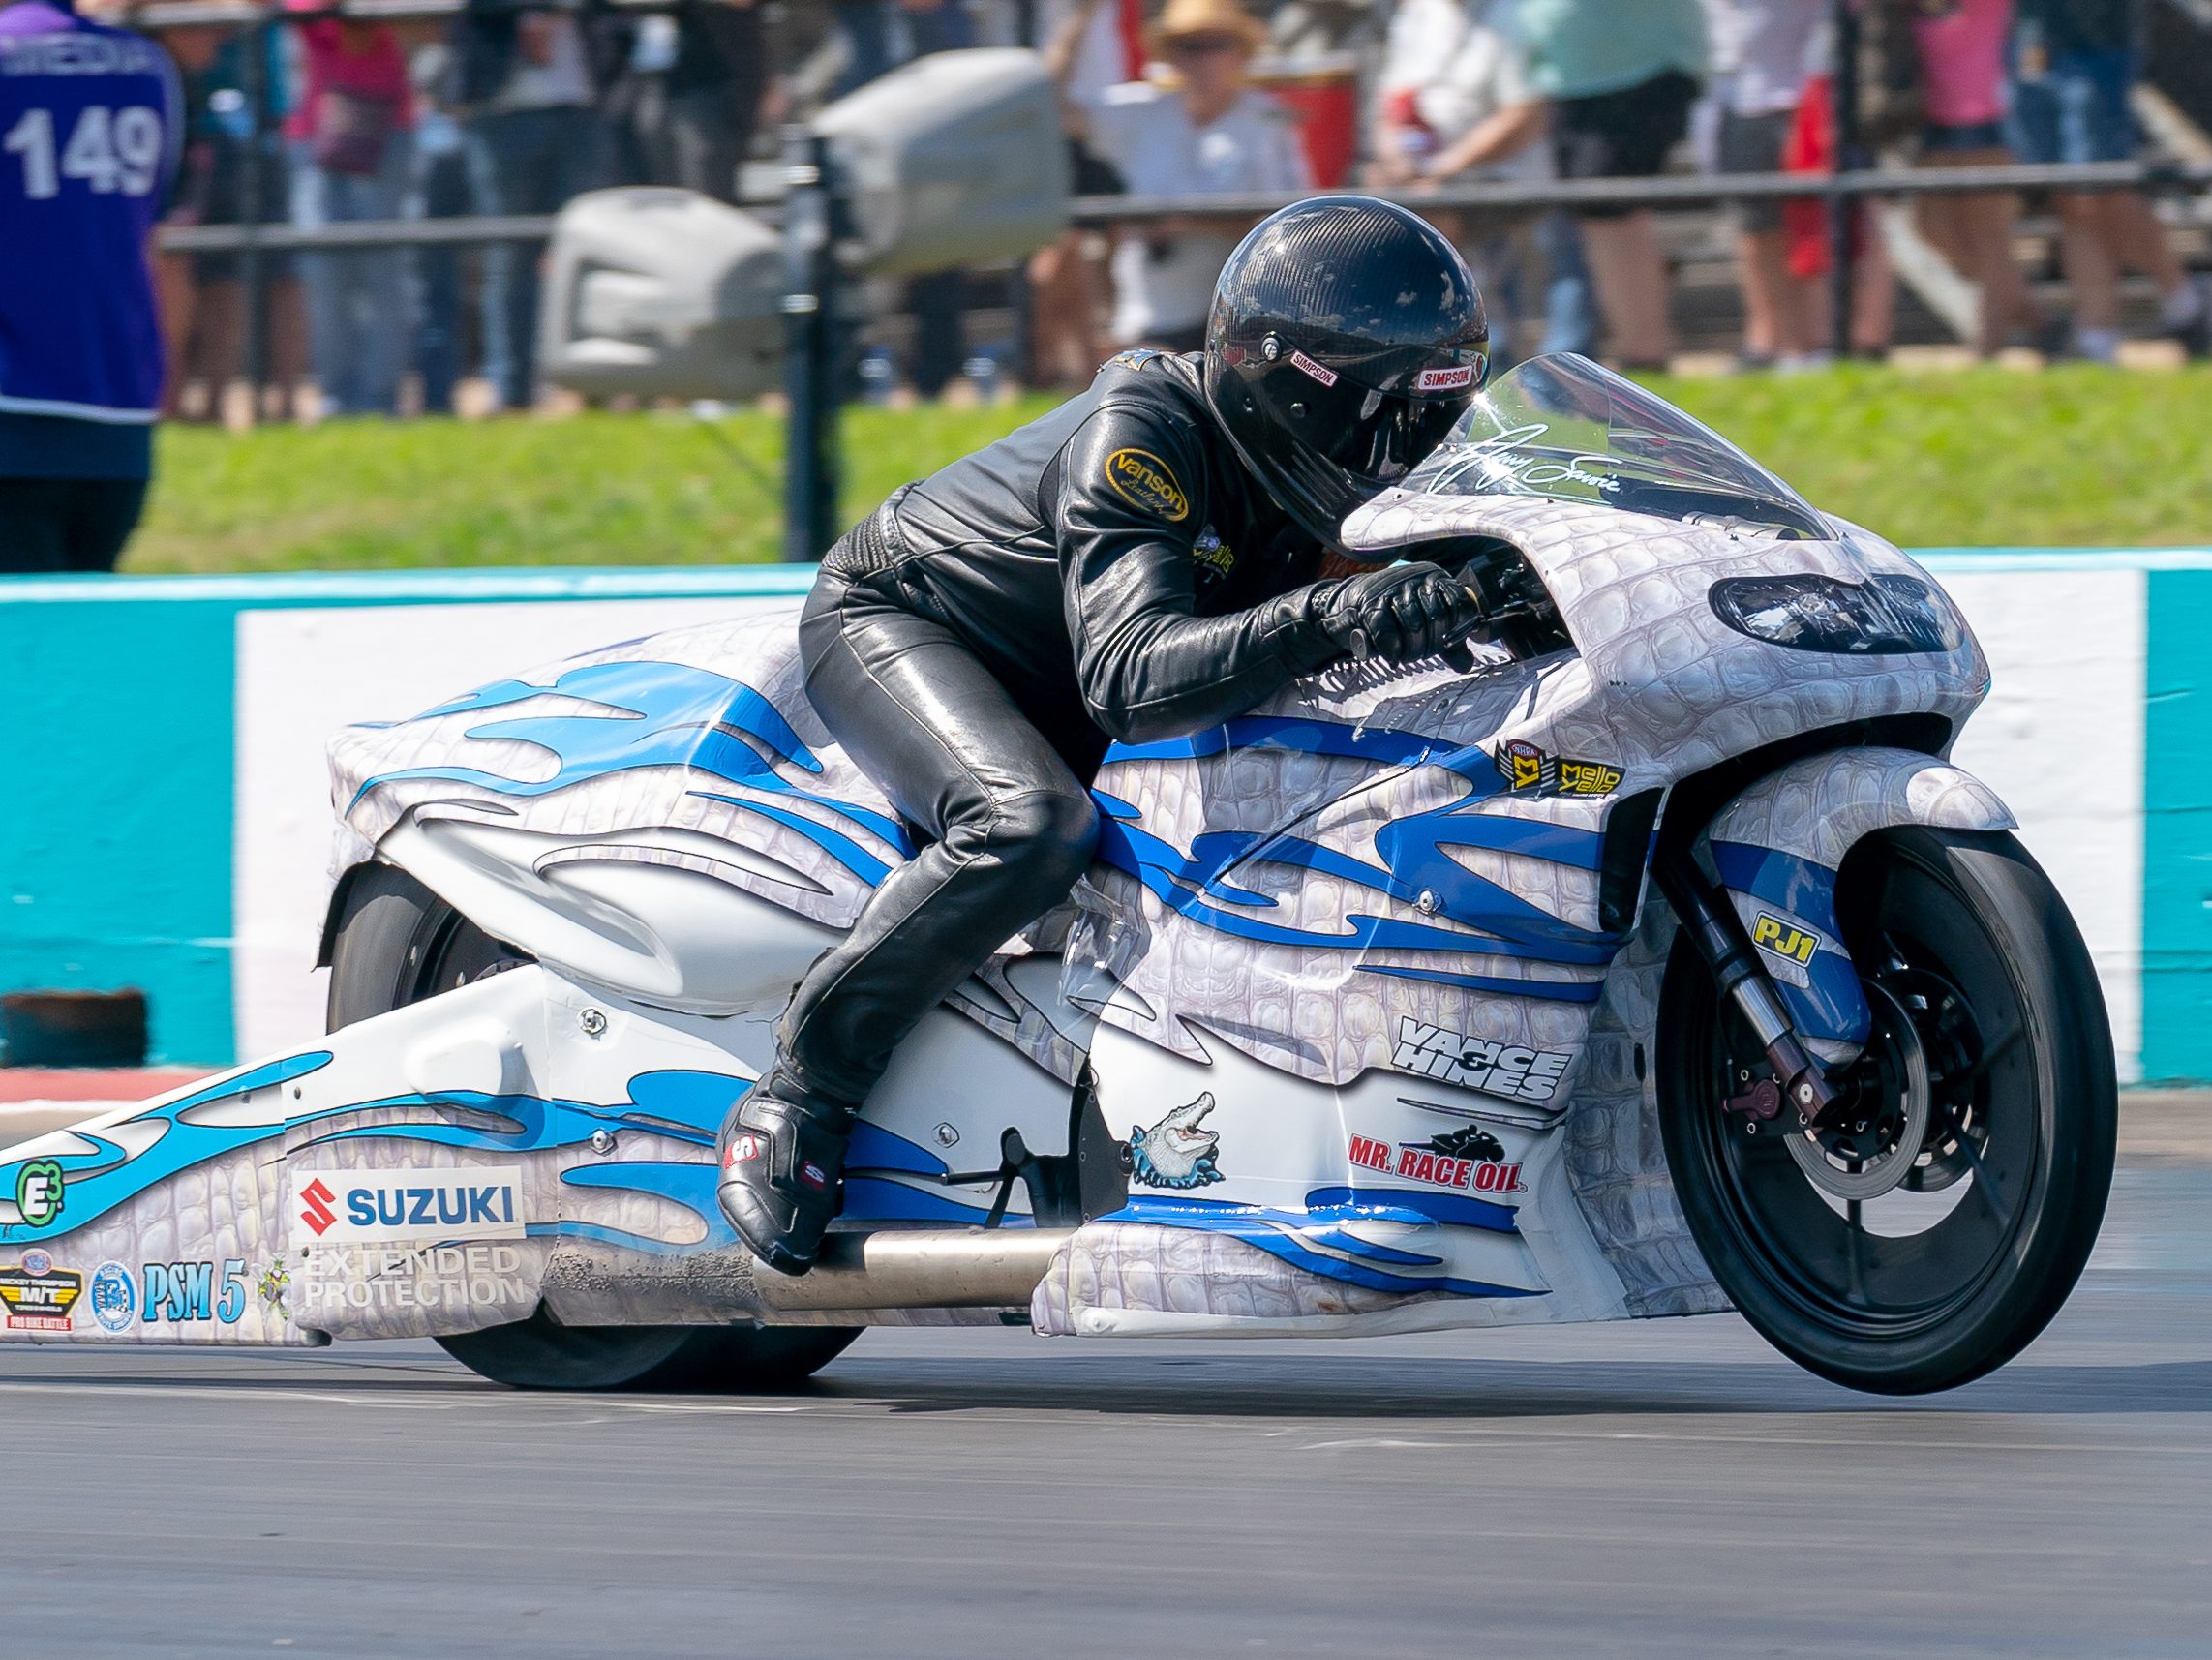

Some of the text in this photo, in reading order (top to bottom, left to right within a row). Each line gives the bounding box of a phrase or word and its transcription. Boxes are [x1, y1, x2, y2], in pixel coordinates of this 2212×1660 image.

[3, 105, 163, 199] 149
[1292, 353, 1334, 385] SIMPSON
[1423, 367, 1470, 386] SIMPSON
[1754, 917, 1815, 962] PJ1
[1398, 1016, 1573, 1077] VANCE
[1391, 1043, 1561, 1101] HINES
[1349, 1133, 1394, 1172] MR.
[1398, 1146, 1474, 1190] RACE
[347, 1186, 514, 1226] SUZUKI
[303, 1246, 522, 1277] EXTENDED
[19, 1286, 60, 1304] M/T
[142, 1258, 246, 1323] PSM 5
[304, 1277, 527, 1308] PROTECTION
